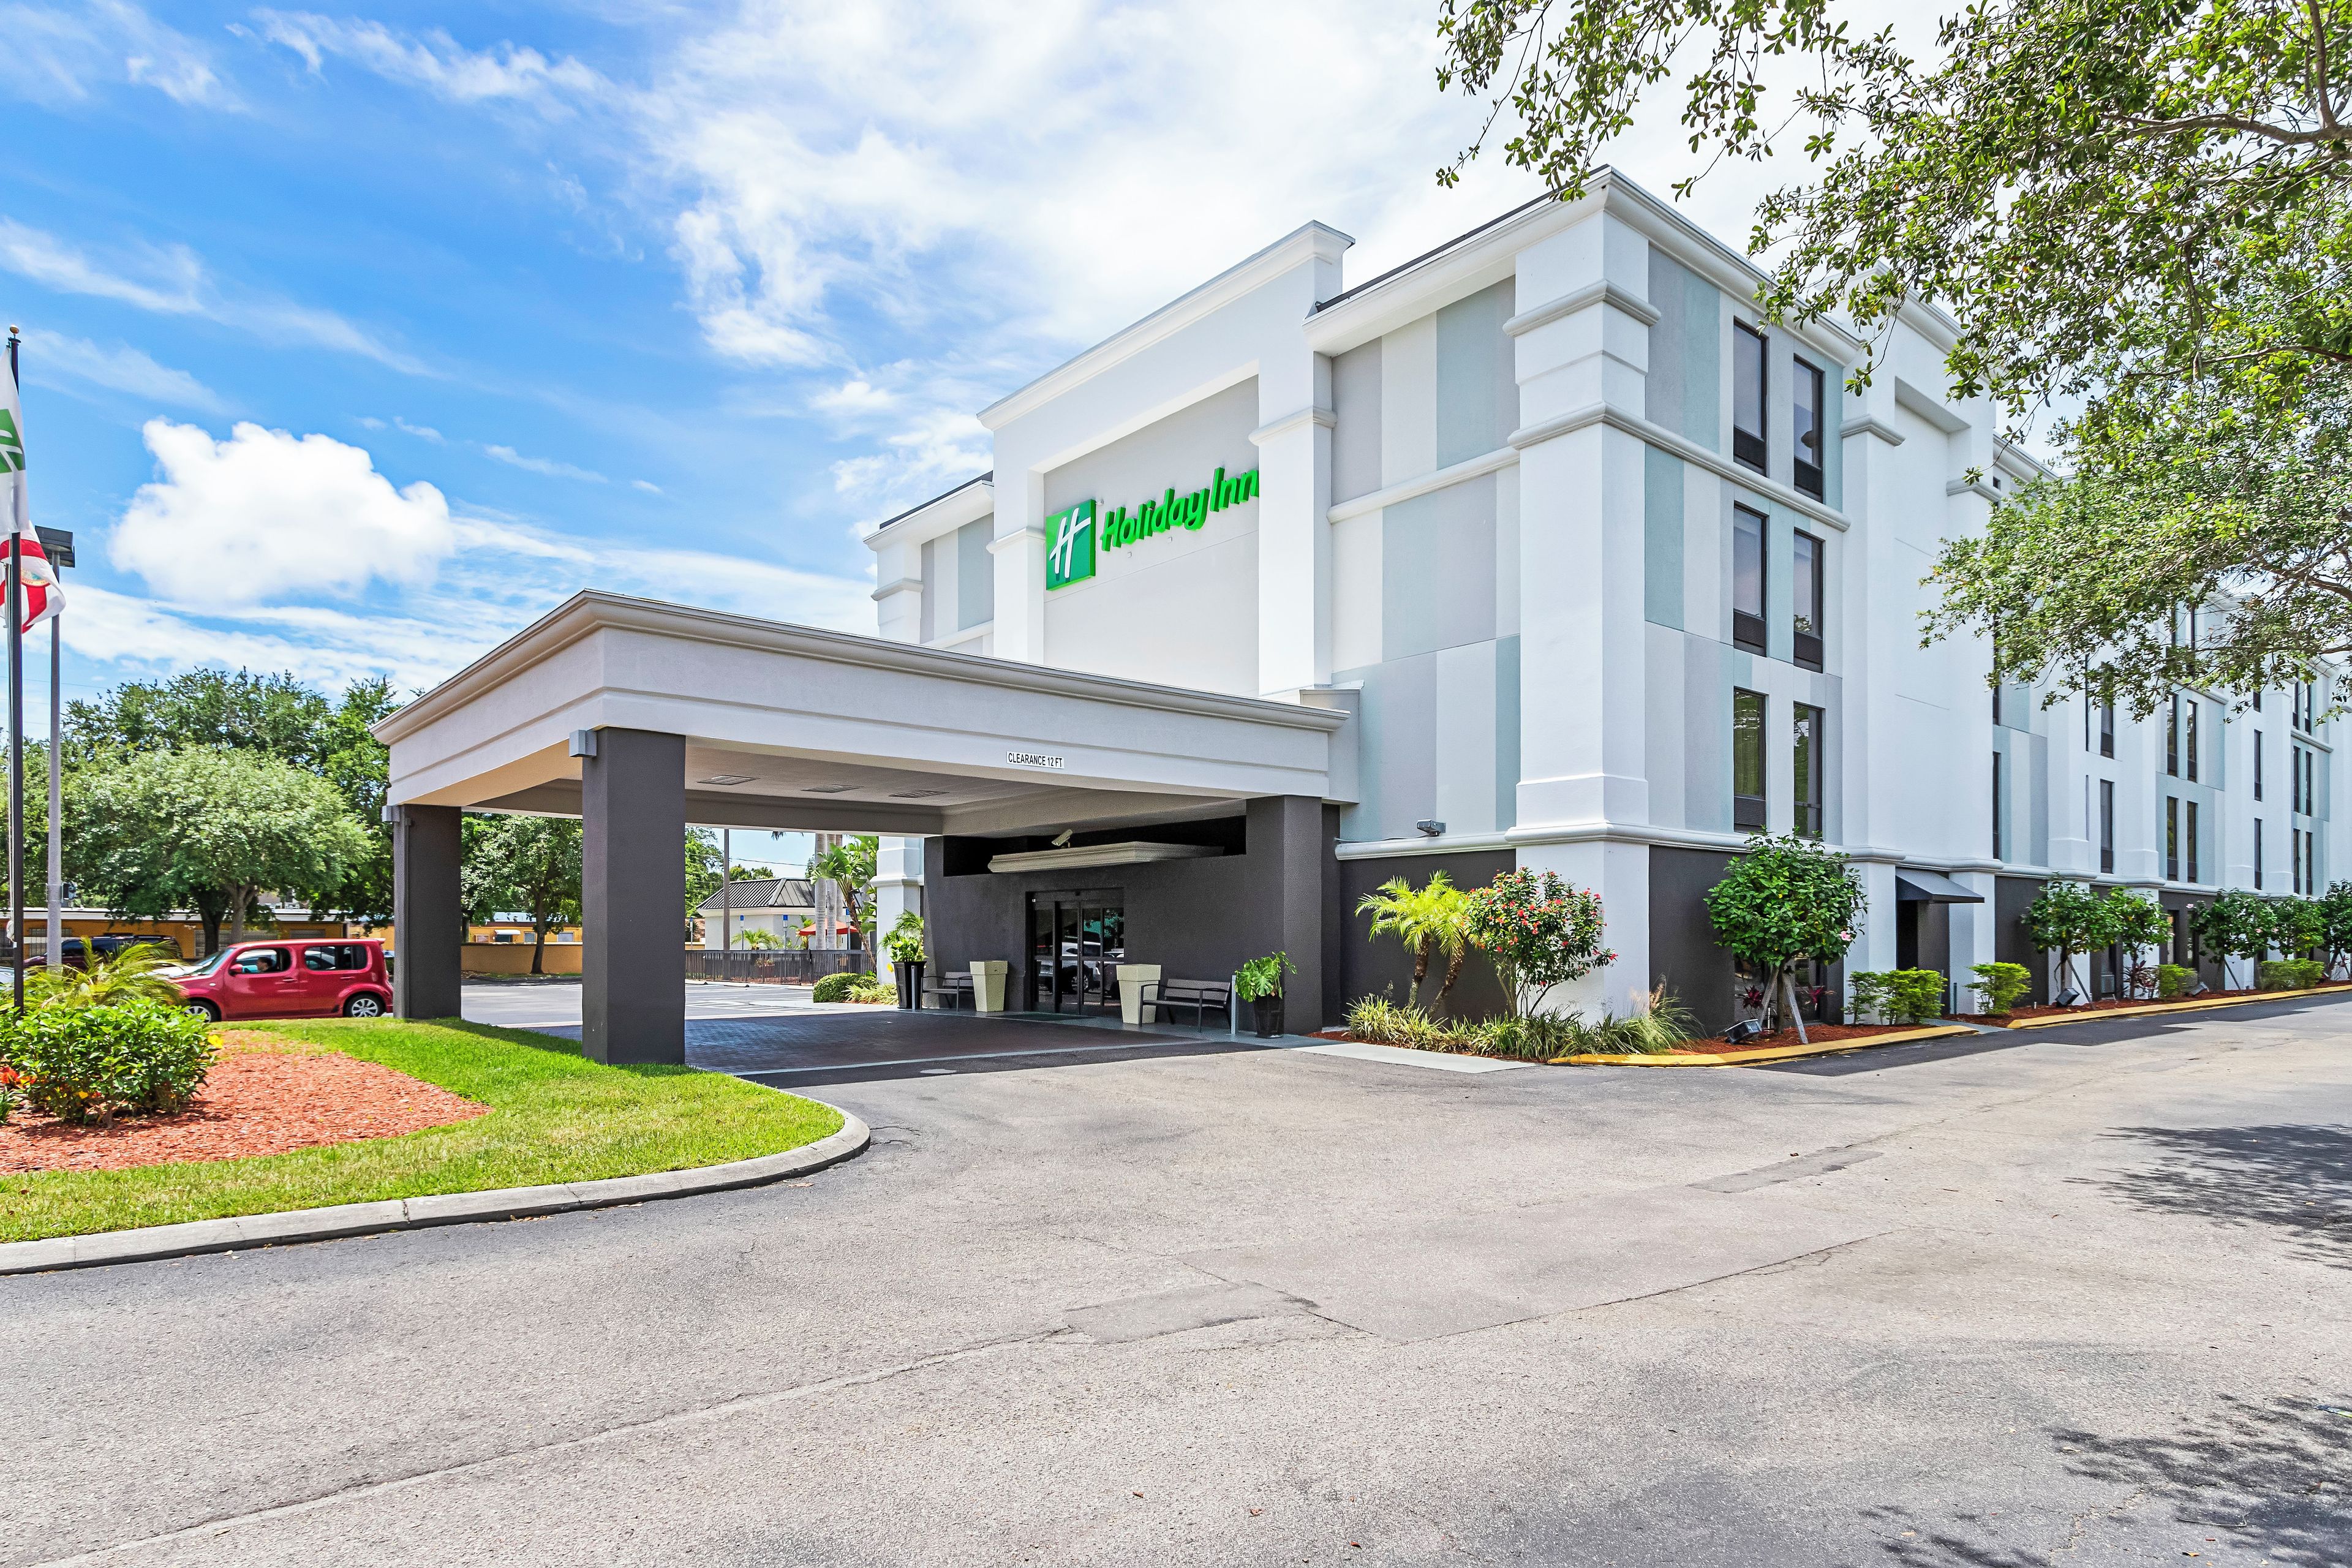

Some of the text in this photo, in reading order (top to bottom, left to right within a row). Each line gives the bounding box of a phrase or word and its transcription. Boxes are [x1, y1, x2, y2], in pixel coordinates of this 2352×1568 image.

[1100, 467, 1259, 552] Holiday Inn
[1008, 753, 1063, 767] CLEARANCE 12 FT
